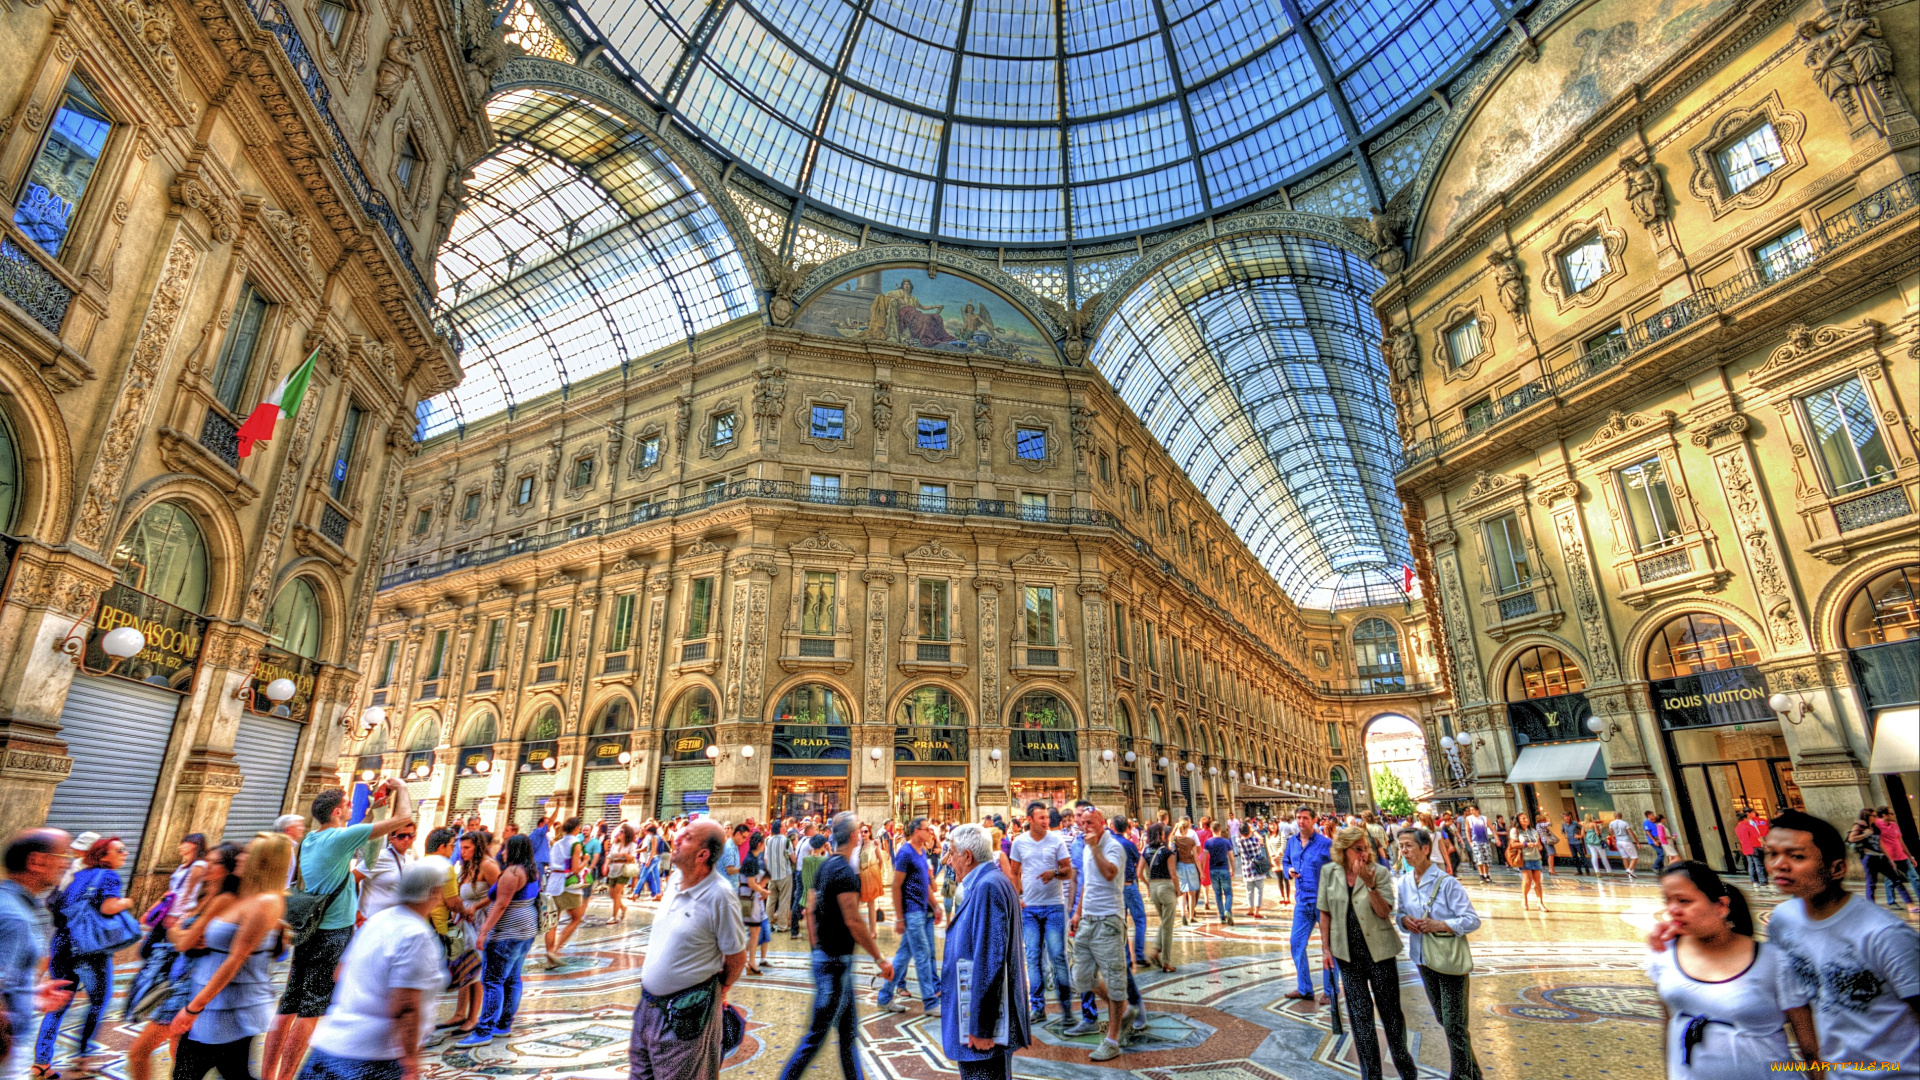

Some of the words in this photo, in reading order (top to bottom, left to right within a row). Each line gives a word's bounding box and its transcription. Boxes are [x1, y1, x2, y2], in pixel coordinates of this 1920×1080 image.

[32, 186, 73, 218] CAI
[1664, 695, 1702, 710] LOUIS
[1703, 687, 1765, 705] VUITTON
[793, 738, 830, 746] PRADA
[914, 741, 949, 749] PRADA
[1027, 742, 1059, 750] PRADA
